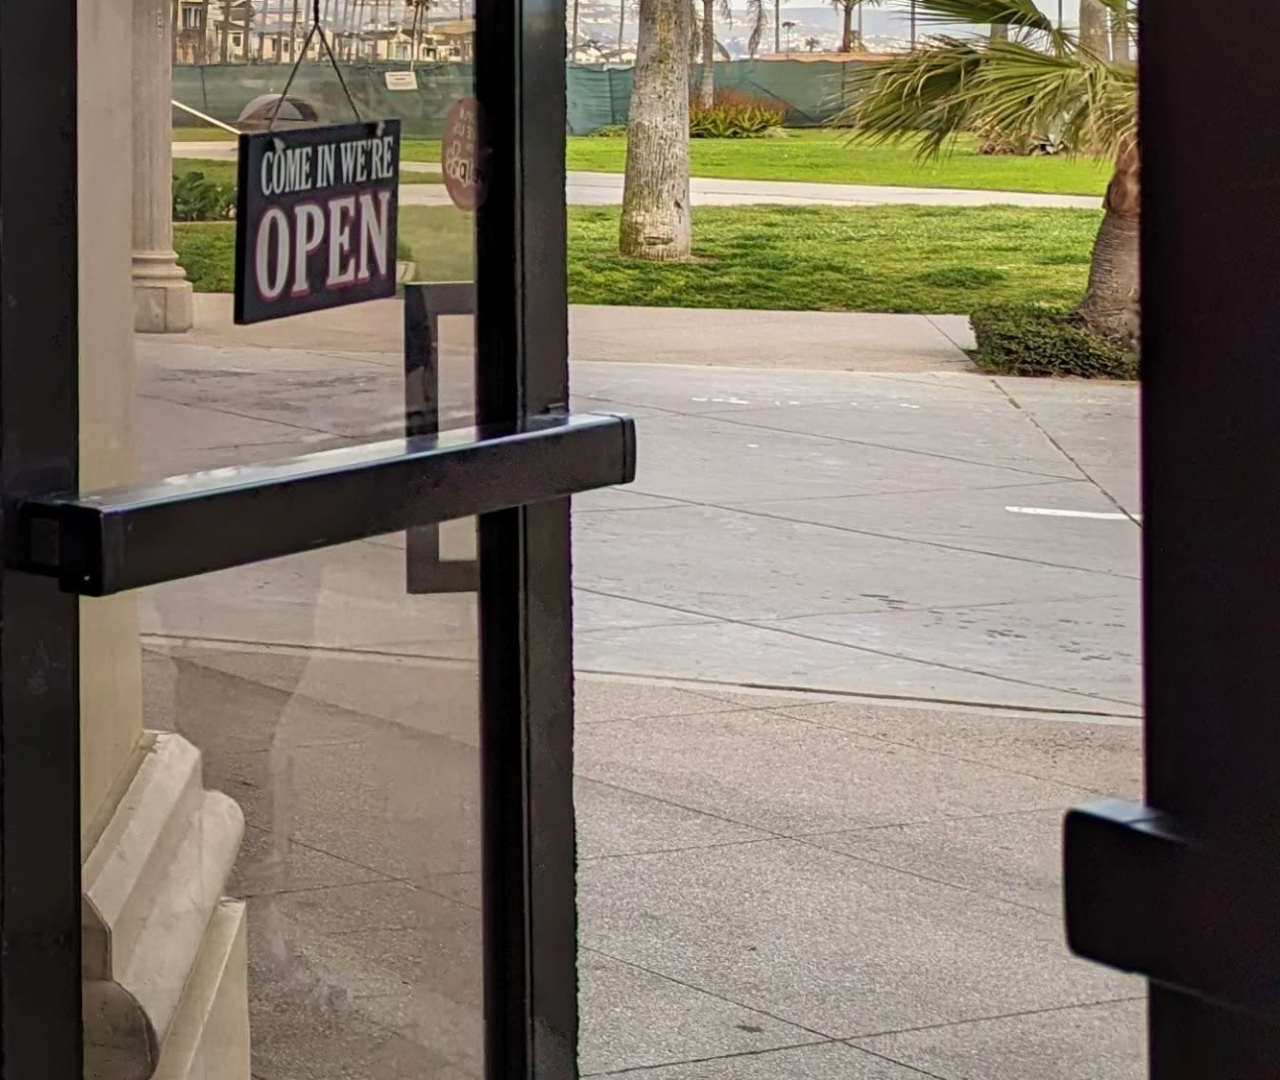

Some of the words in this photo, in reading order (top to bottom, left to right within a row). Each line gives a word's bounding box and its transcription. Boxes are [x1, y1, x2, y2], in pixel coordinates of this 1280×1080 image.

[261, 146, 312, 196] COME
[316, 143, 336, 188] IN
[340, 136, 393, 184] WE'RE
[255, 191, 390, 300] OPEN
